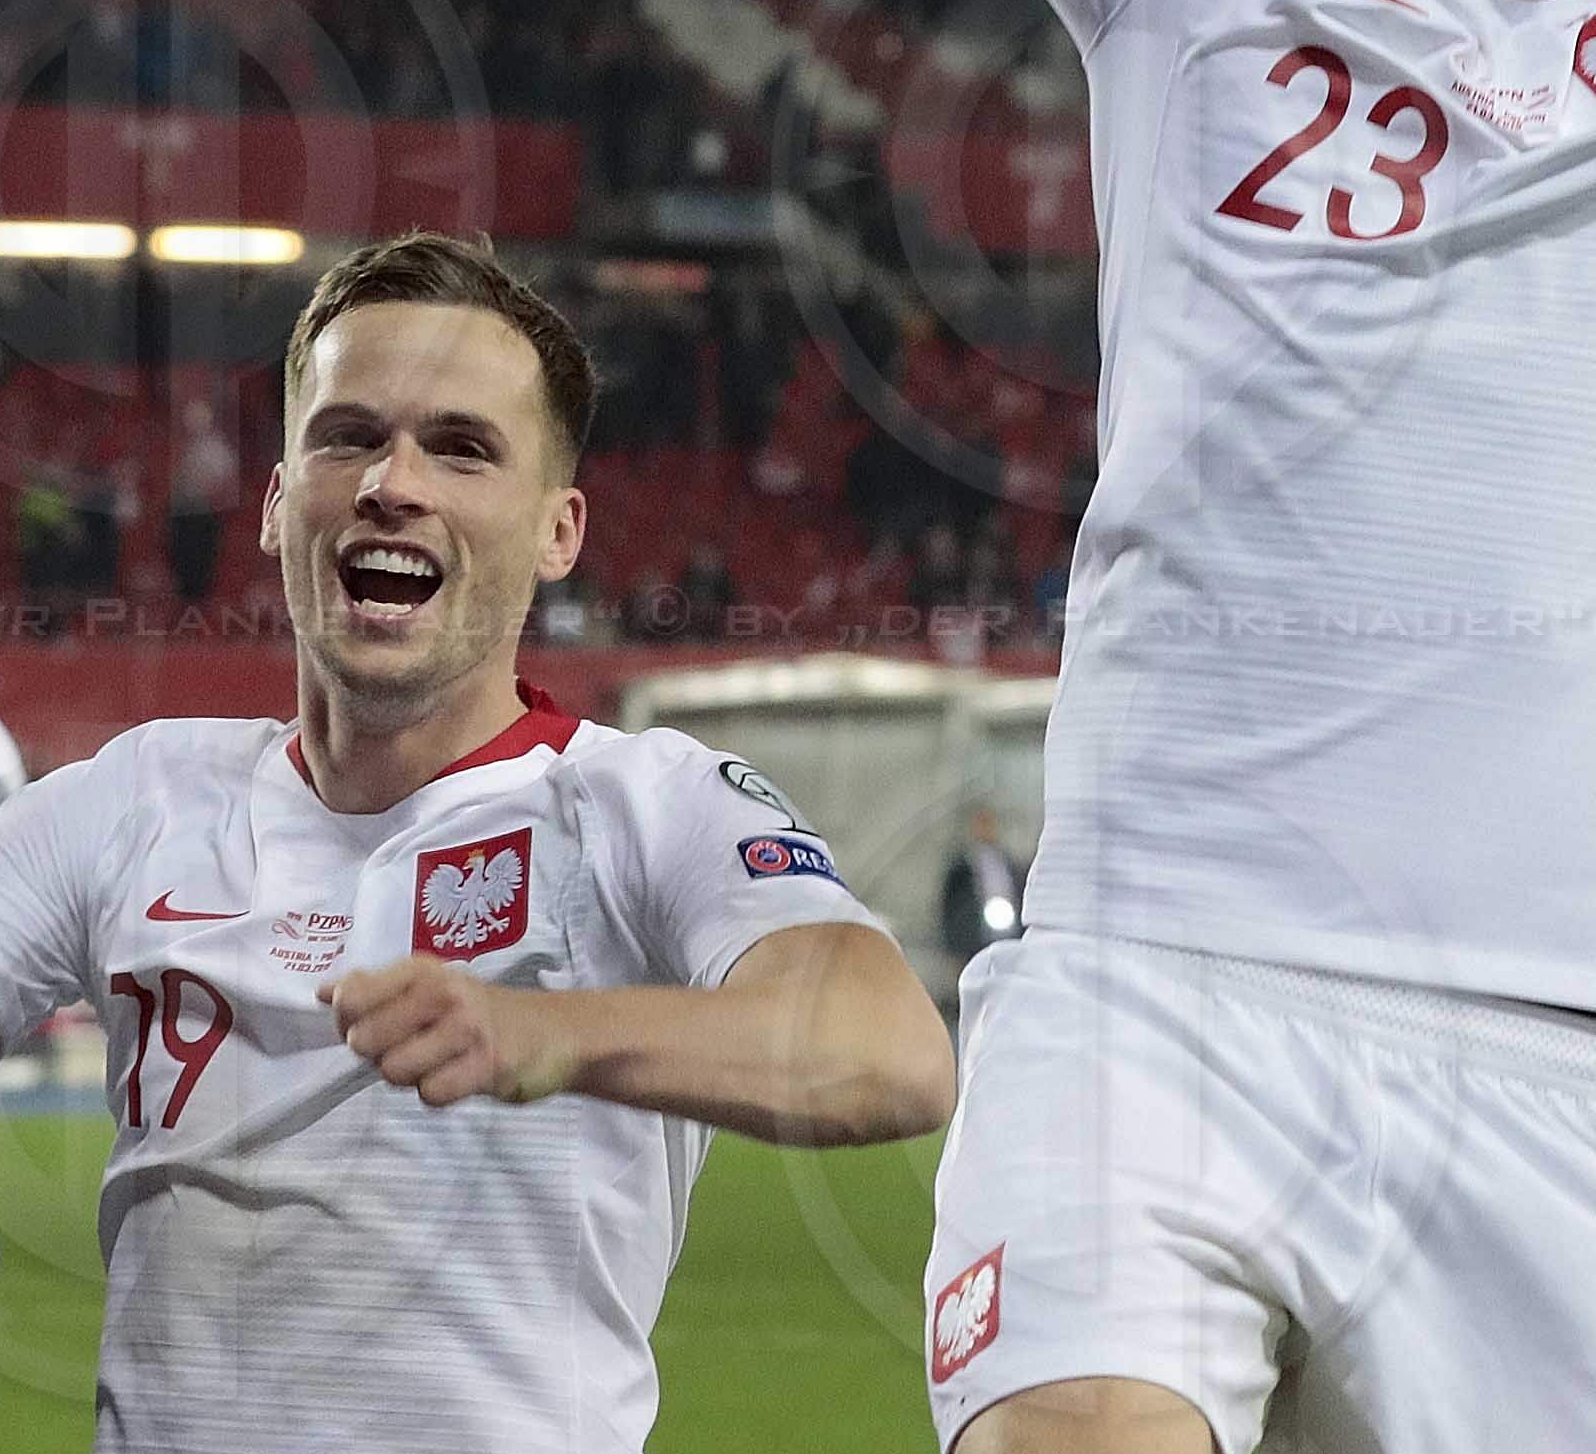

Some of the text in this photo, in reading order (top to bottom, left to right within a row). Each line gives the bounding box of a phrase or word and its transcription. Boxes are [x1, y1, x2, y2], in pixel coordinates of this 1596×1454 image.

[1214, 45, 1449, 240] 23
[308, 913, 347, 929] PZPN
[110, 968, 233, 1129] 19
